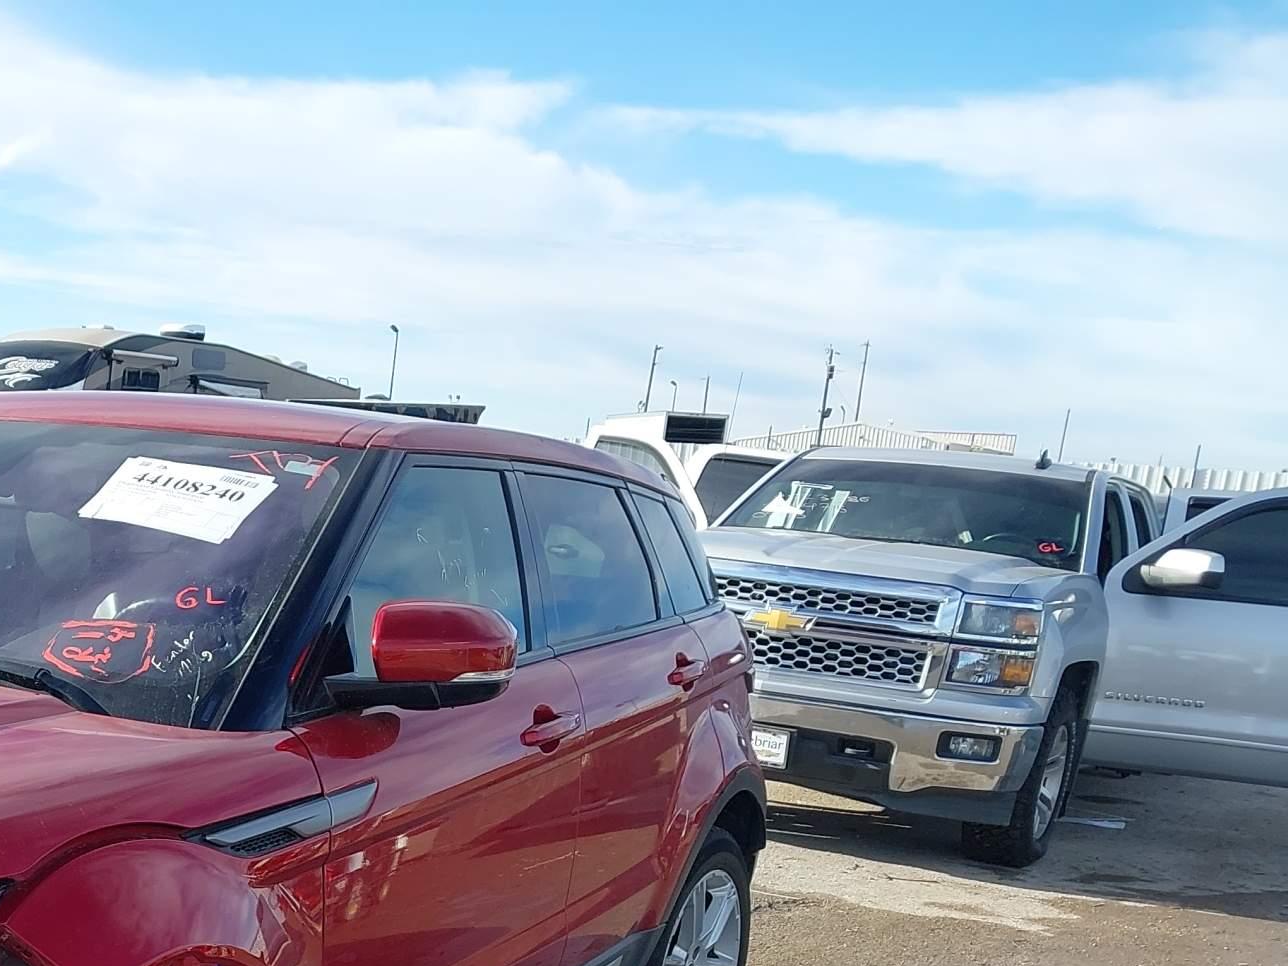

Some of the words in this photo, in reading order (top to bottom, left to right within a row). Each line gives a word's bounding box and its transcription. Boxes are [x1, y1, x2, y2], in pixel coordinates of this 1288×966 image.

[132, 471, 246, 503] 44108240
[1038, 542, 1065, 553] GL
[1103, 690, 1206, 709] SILVERADO
